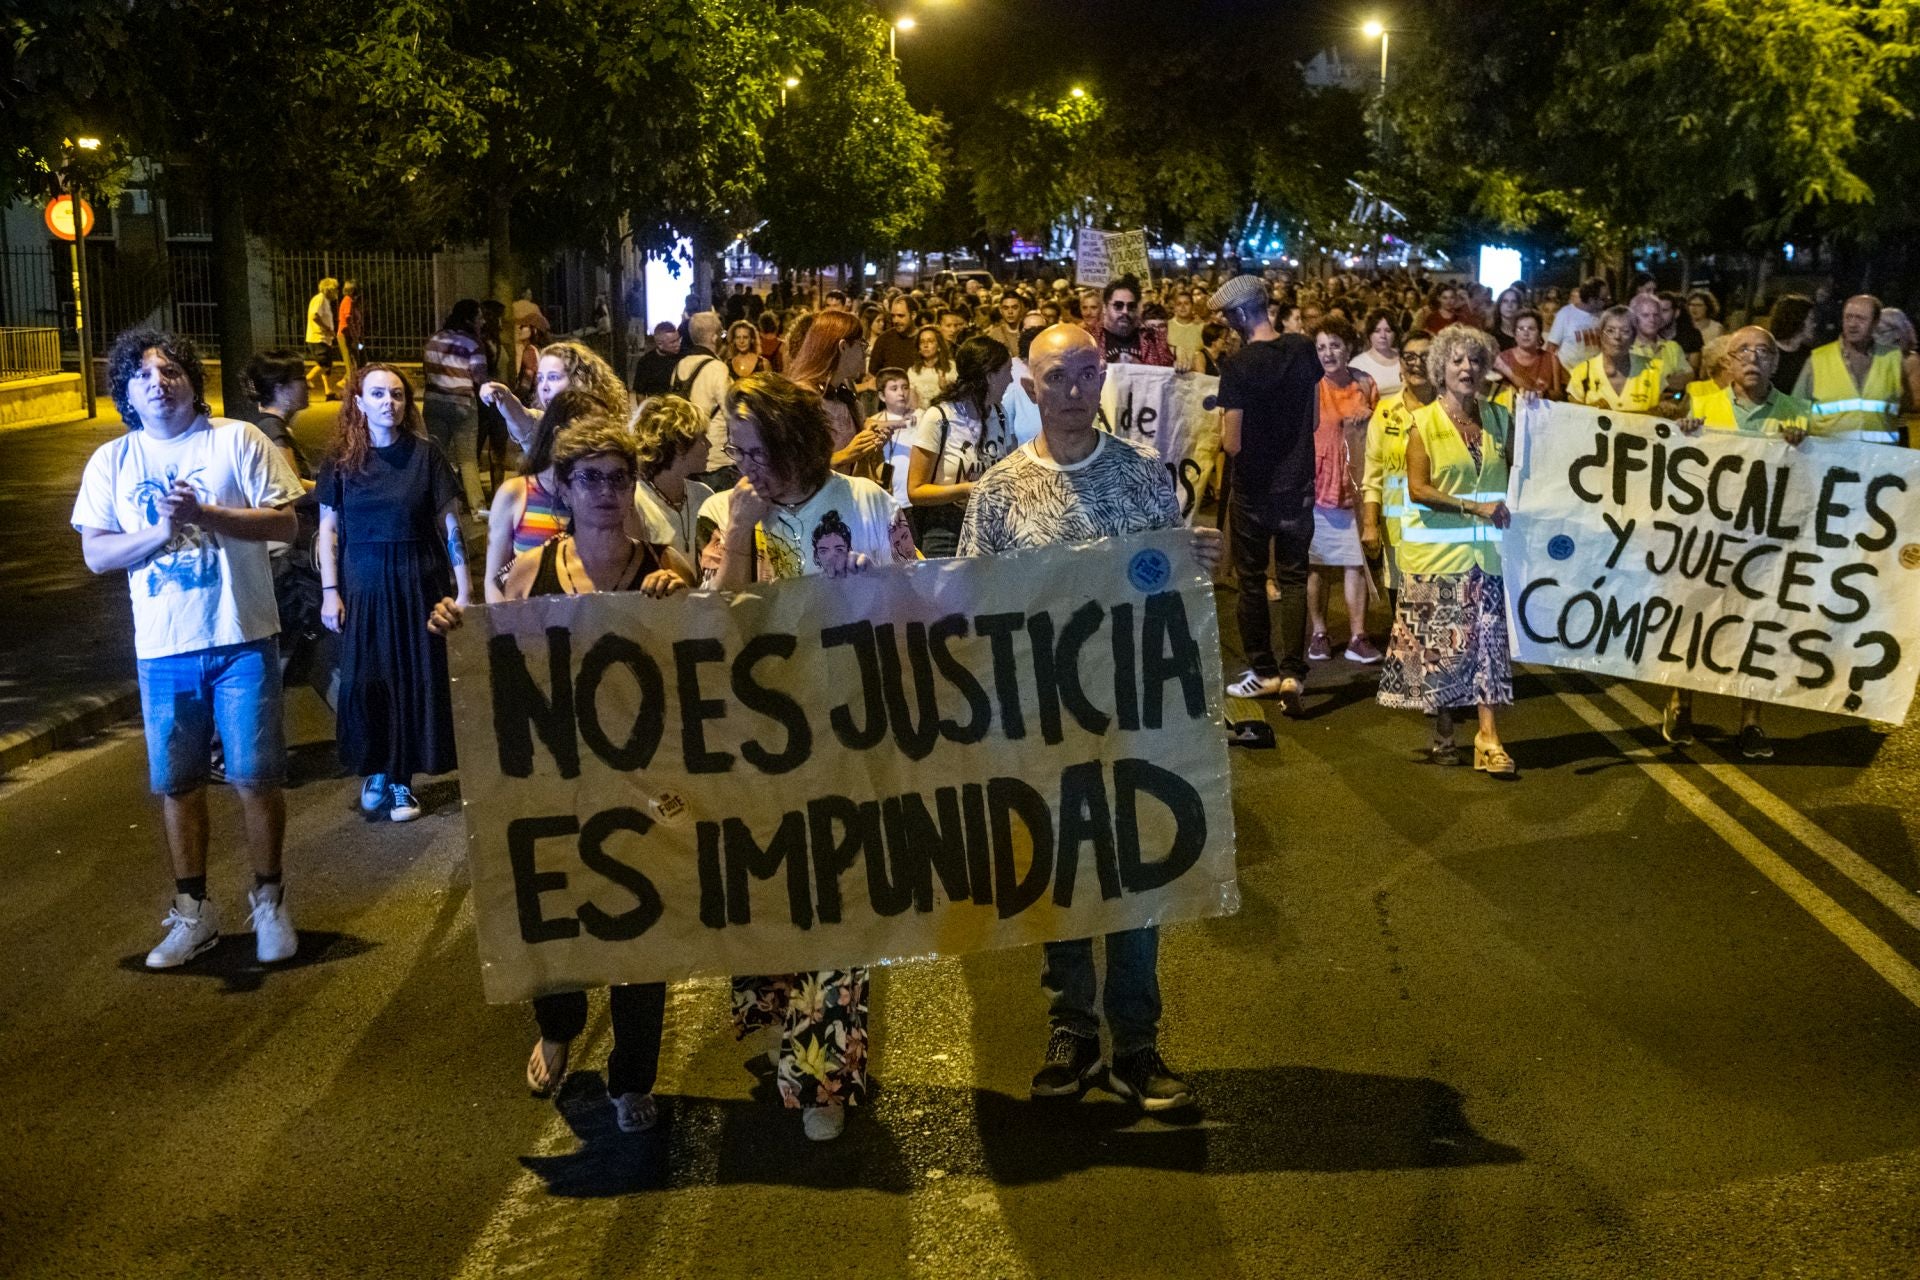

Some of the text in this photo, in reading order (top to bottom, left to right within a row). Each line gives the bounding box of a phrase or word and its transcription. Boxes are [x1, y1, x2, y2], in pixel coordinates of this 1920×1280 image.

[1120, 391, 1158, 437] de
[1602, 512, 1879, 623] Y JUECES
[488, 591, 1207, 779] NO ES JUSTICIA
[1517, 576, 1901, 712] CÓMPLICES?
[507, 758, 1208, 943] ES IMPUNIDAD
